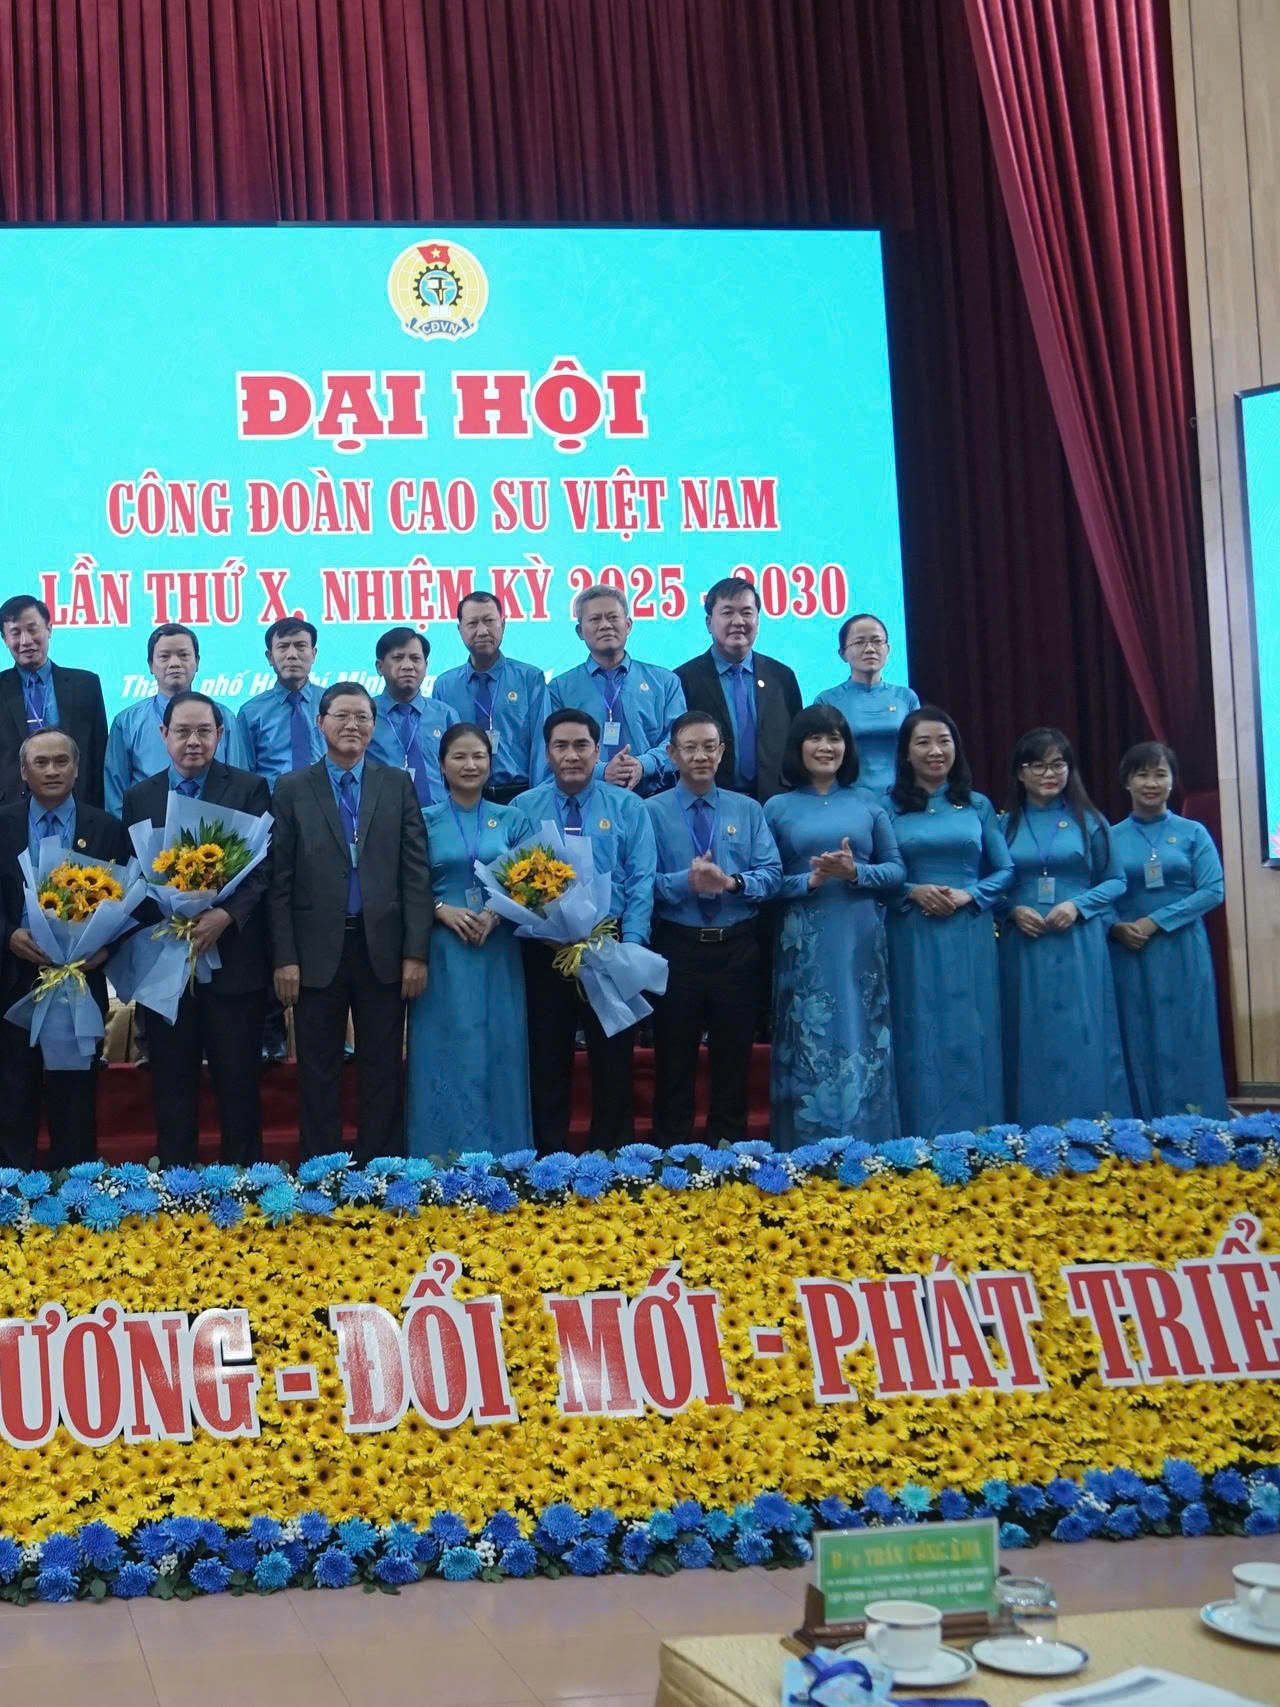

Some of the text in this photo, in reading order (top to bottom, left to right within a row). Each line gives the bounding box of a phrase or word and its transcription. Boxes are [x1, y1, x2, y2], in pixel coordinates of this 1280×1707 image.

[238, 358, 646, 452] ĐẠI HỘI
[108, 467, 778, 540] CÔNG ĐOÀN CAO SU VIỆT NAM
[41, 555, 129, 625] LẦN
[146, 558, 246, 624] THỨ
[323, 556, 474, 631] NHIỆM
[491, 555, 552, 619] KỲ
[336, 1258, 511, 1425] ĐỔI
[549, 1267, 735, 1413] MỚI
[800, 1256, 1040, 1395] PHÁT
[1066, 1218, 1280, 1379] TRIỂ
